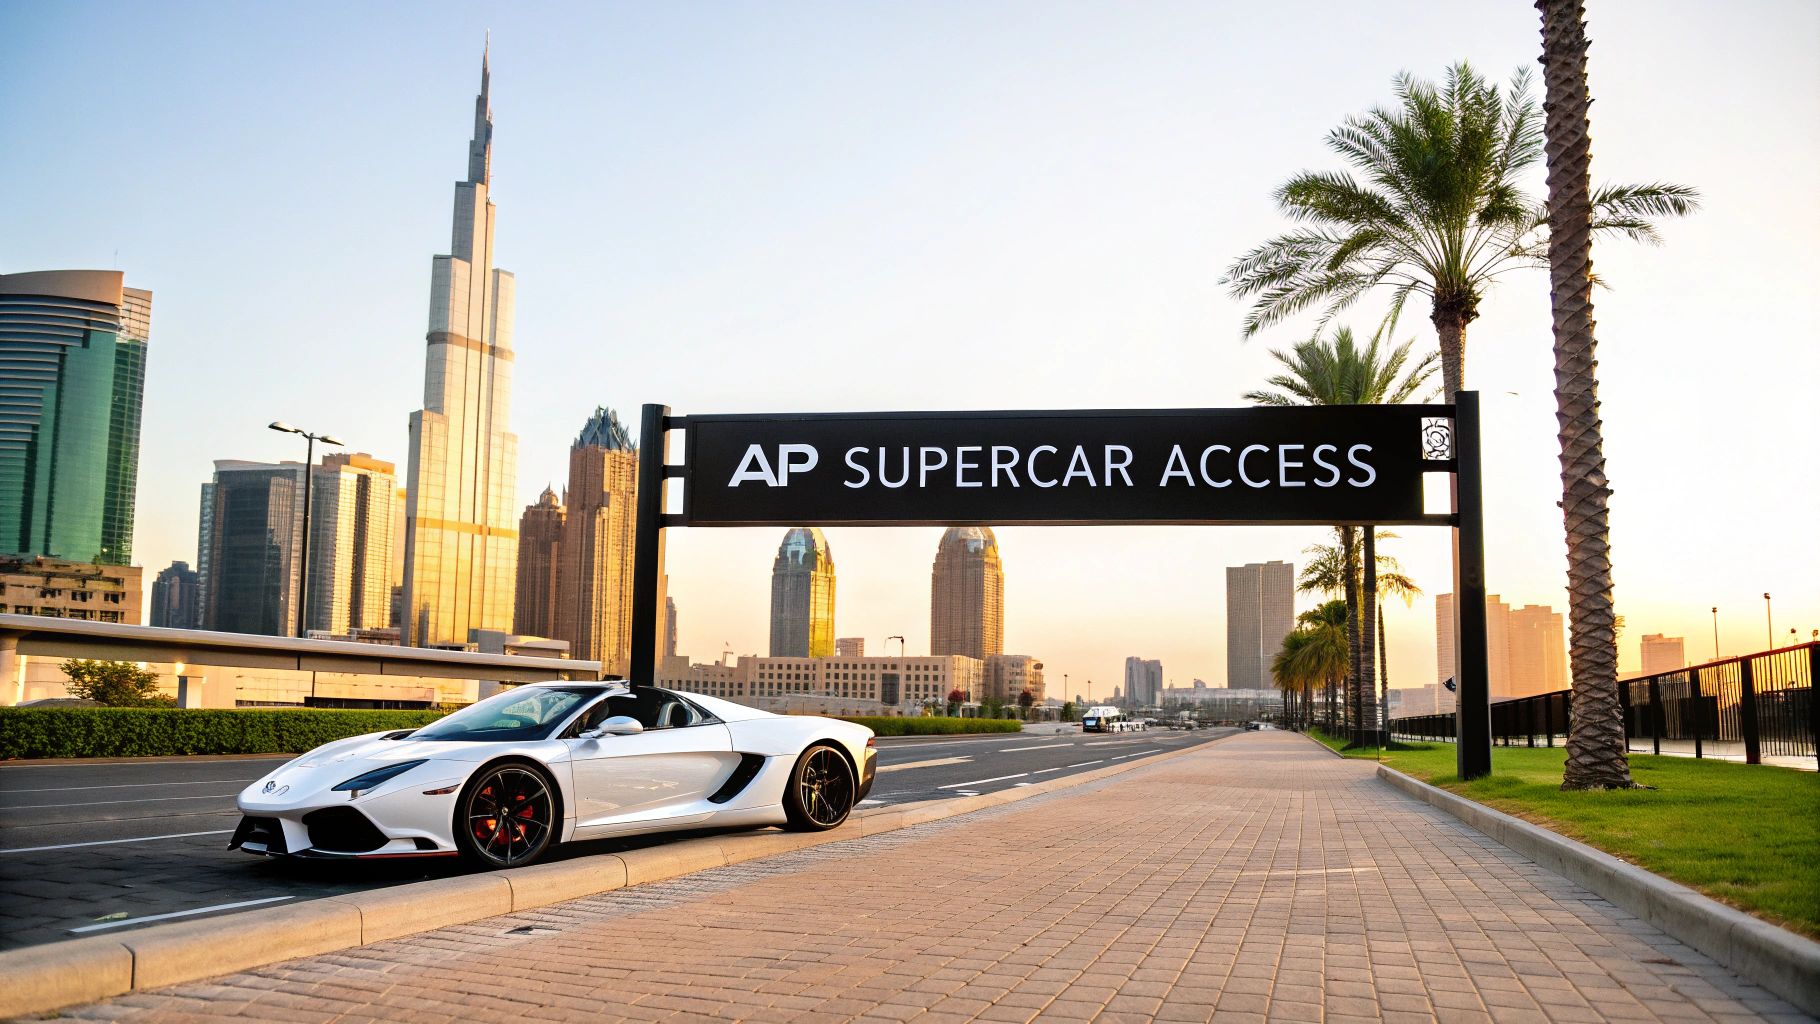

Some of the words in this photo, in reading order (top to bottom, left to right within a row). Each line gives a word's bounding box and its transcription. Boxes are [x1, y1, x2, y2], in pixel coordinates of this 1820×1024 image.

[728, 443, 818, 487] AP
[843, 445, 1134, 488] SUPERCAR
[1160, 444, 1377, 488] ACCESS
